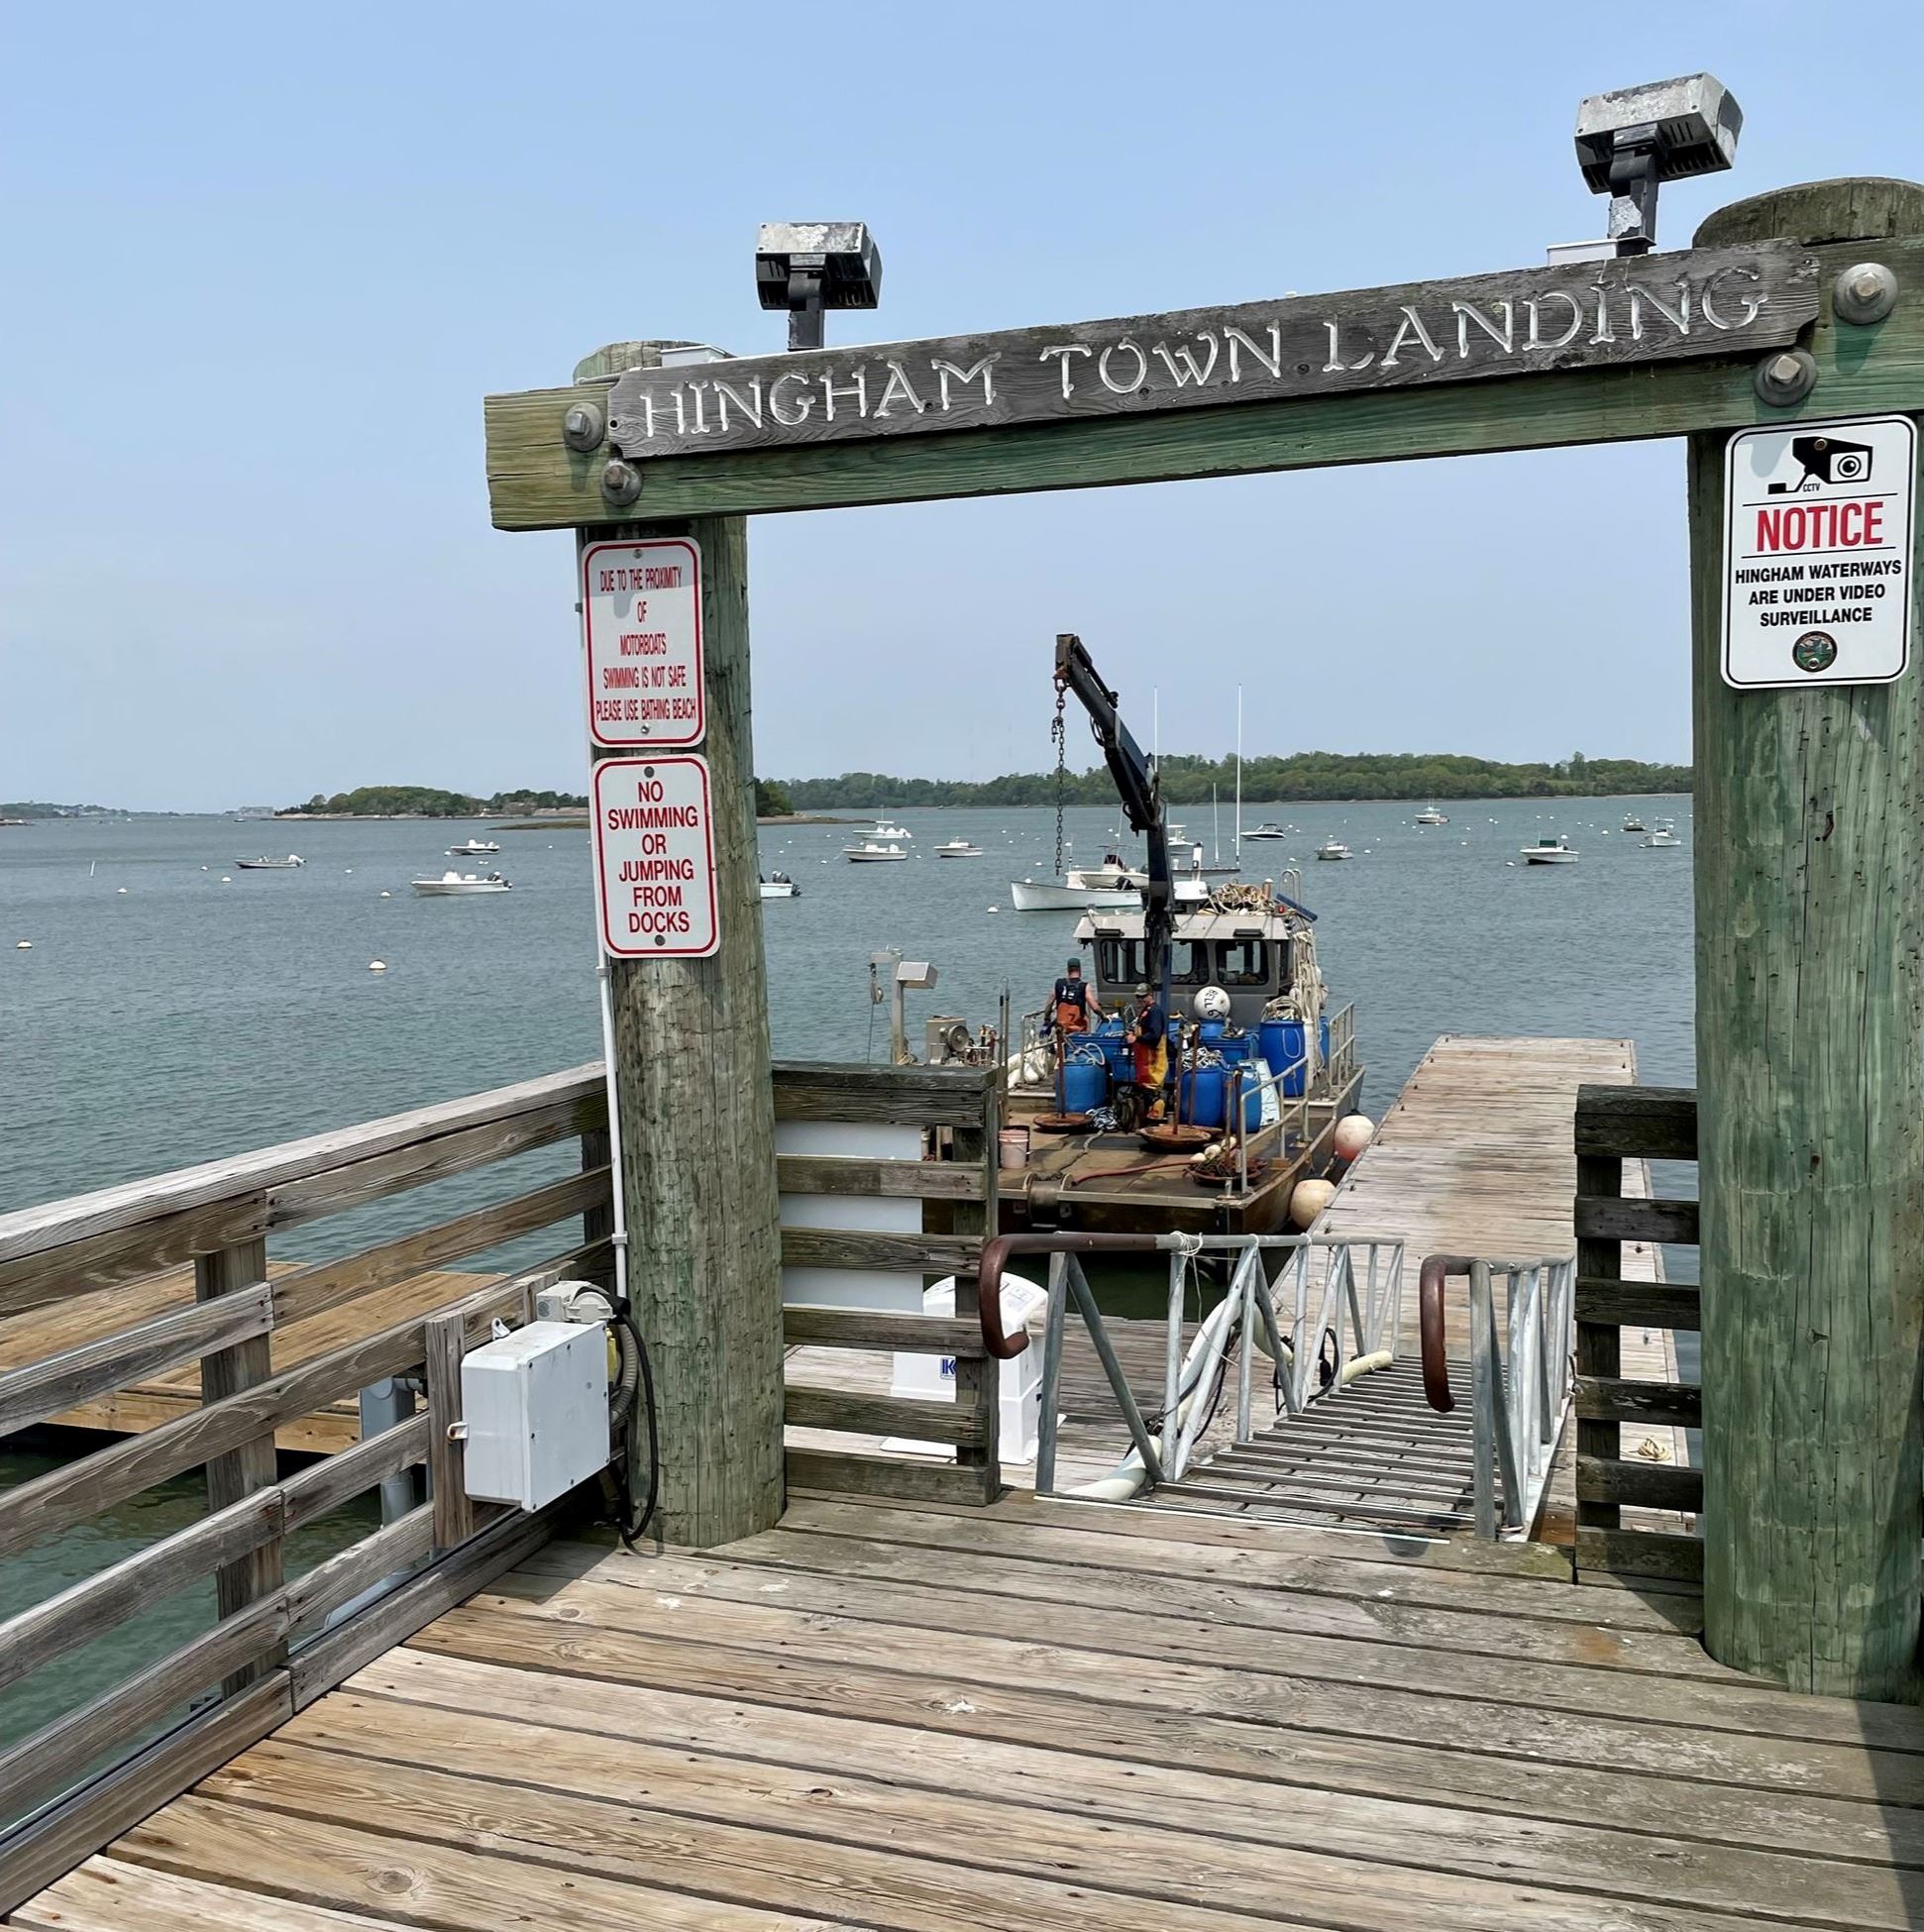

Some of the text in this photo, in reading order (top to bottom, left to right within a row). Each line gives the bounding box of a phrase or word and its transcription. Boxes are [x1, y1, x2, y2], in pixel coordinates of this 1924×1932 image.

[639, 268, 1768, 438] HINGHAM TOWN LANDING
[1802, 483, 1821, 492] CCTV
[1757, 501, 1884, 552] NOTICE
[600, 566, 683, 591] DUE TO THE PROXIMITY
[1735, 560, 1902, 584] HINGHAM WATERWAYS
[1749, 584, 1885, 605] ARE UNDER VIDEO
[637, 600, 648, 623] OF
[1760, 607, 1872, 627] SURVEILLANCE
[619, 632, 667, 656] MOTORBOATS
[603, 665, 687, 690] SWIMMING IS NOT SAFE
[595, 698, 696, 721] PLEASE USE BATHING BEACH
[637, 780, 664, 803] NO
[607, 805, 698, 830] SWIMMING
[642, 833, 667, 855] OR
[618, 858, 695, 882] JUMPING
[633, 886, 683, 908] FROM
[628, 912, 690, 933] DOCKS
